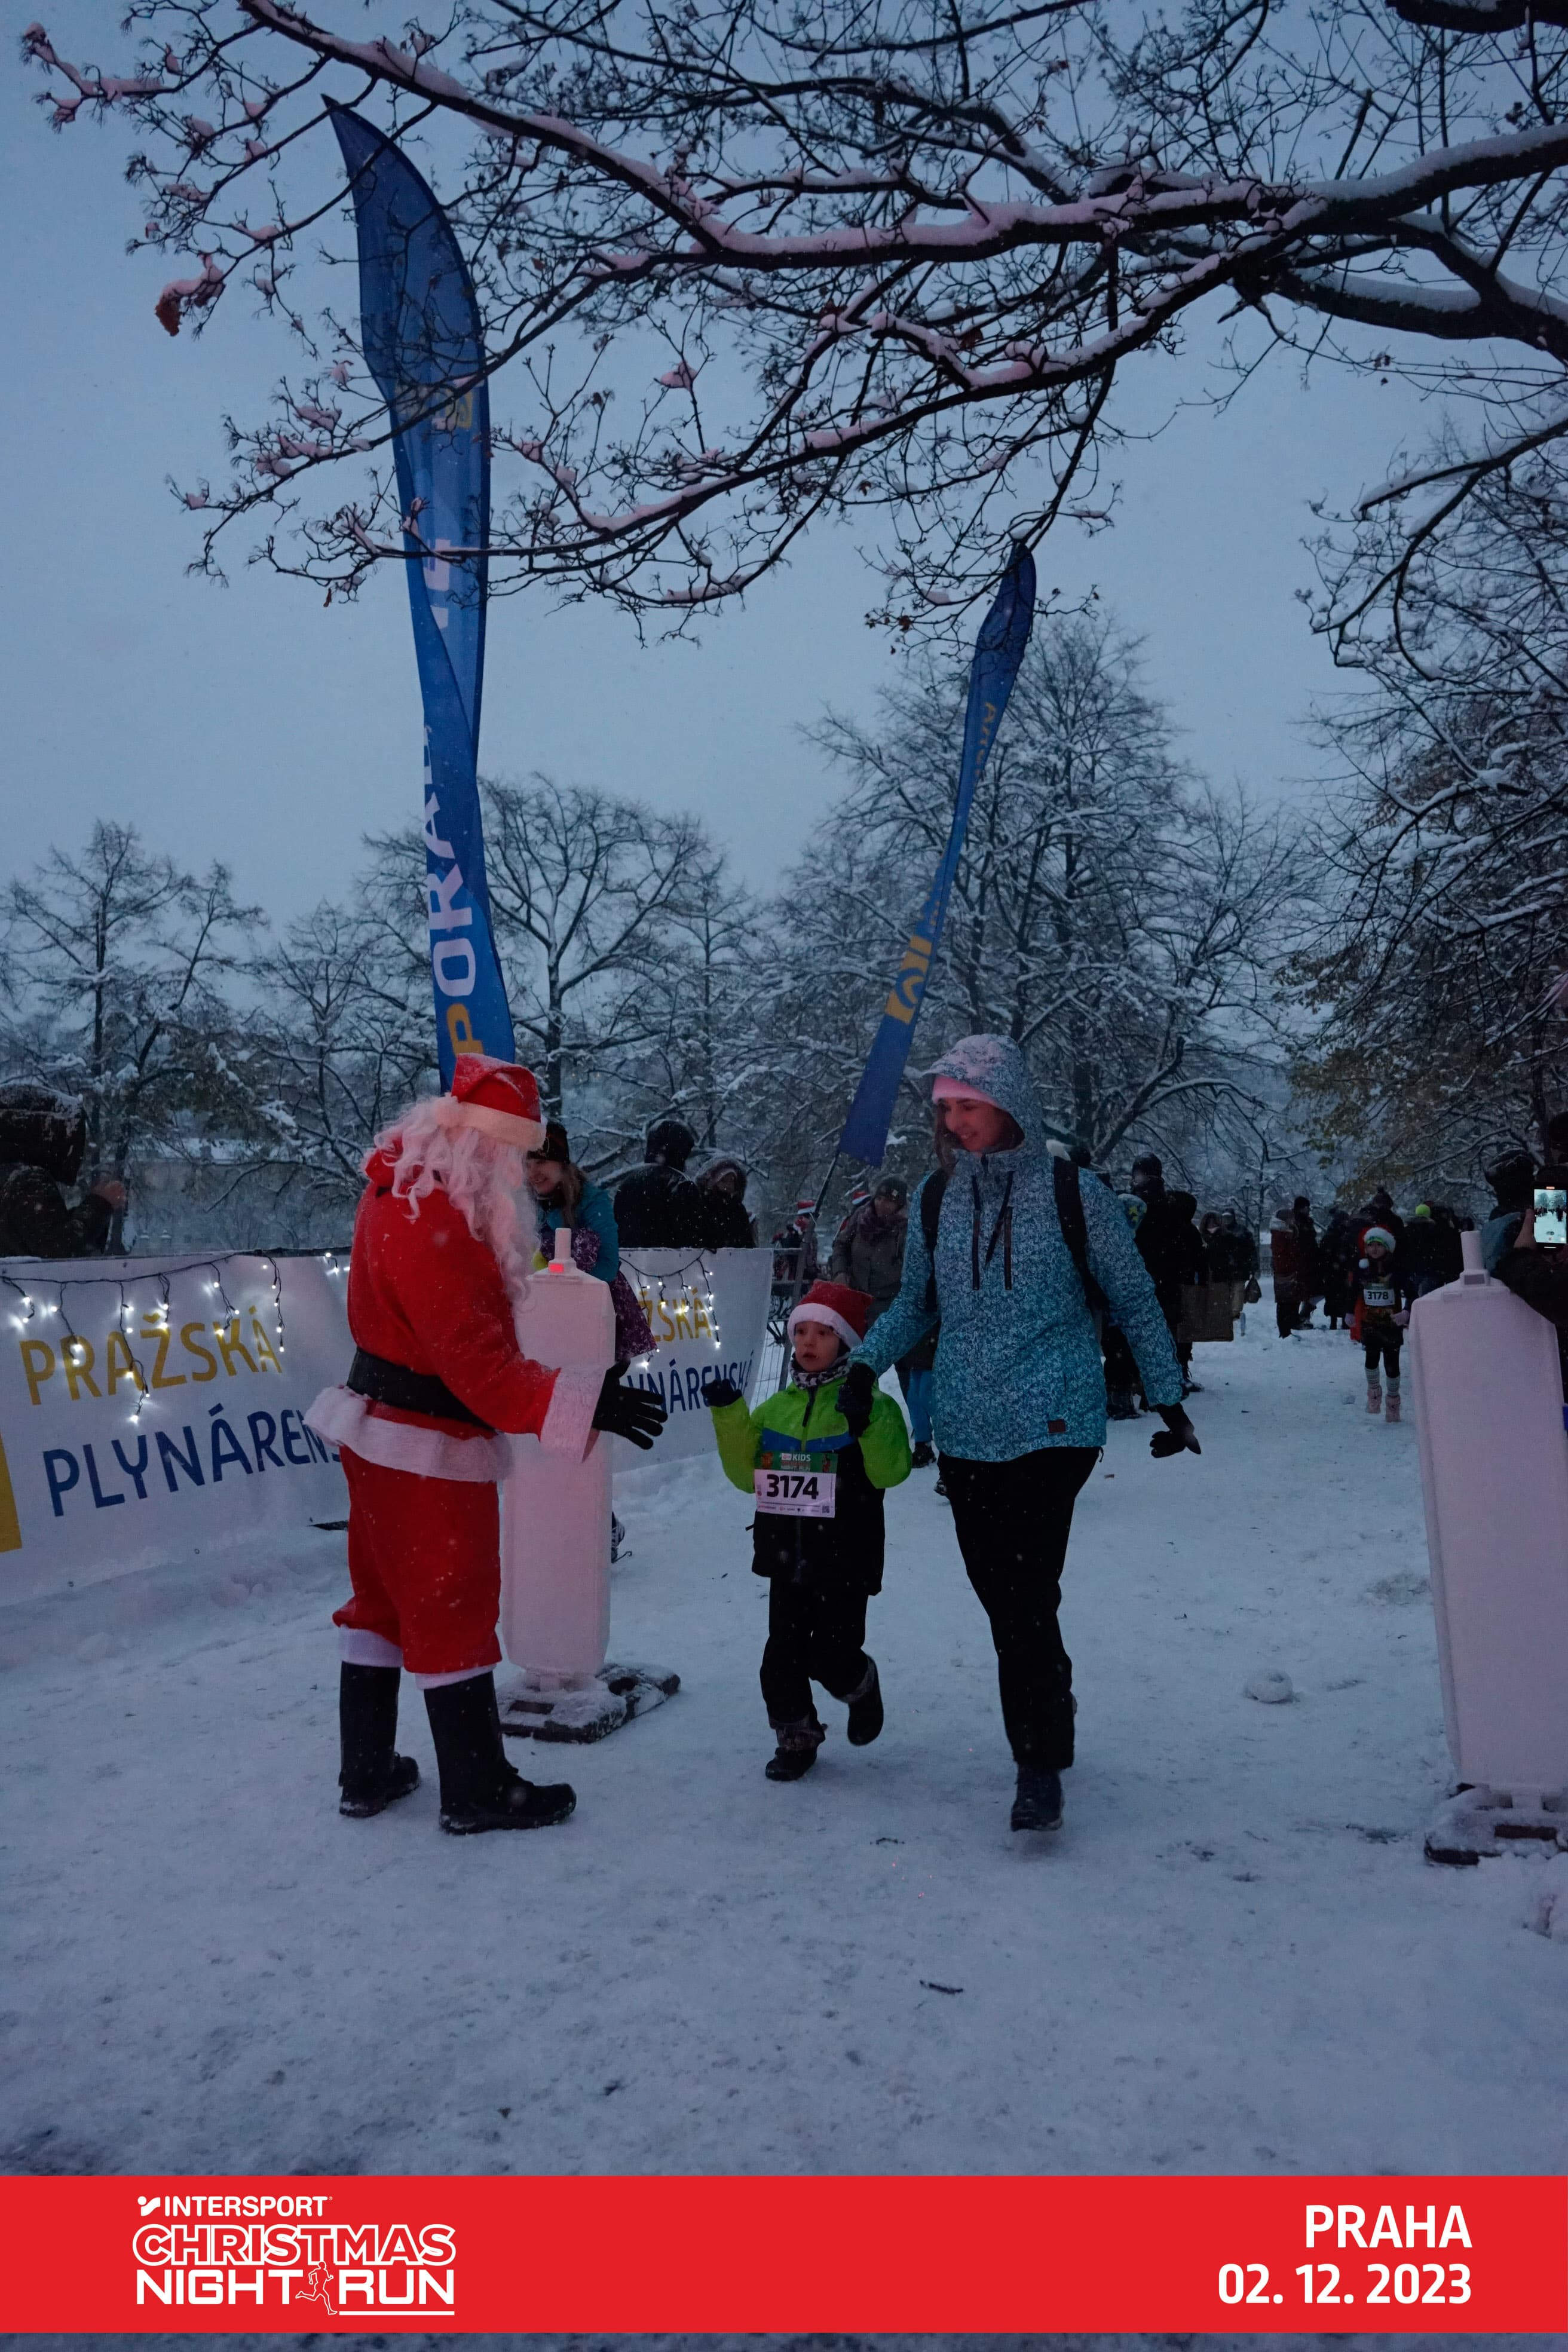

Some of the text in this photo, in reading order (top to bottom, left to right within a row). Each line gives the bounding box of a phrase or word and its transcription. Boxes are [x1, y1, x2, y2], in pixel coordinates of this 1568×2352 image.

[1368, 1291, 1389, 1300] 3178
[20, 1306, 282, 1405] PRAŽSKÁ
[43, 1403, 341, 1517] PLYNÁREN
[792, 1453, 811, 1462] KIDS
[767, 1474, 819, 1499] 3174
